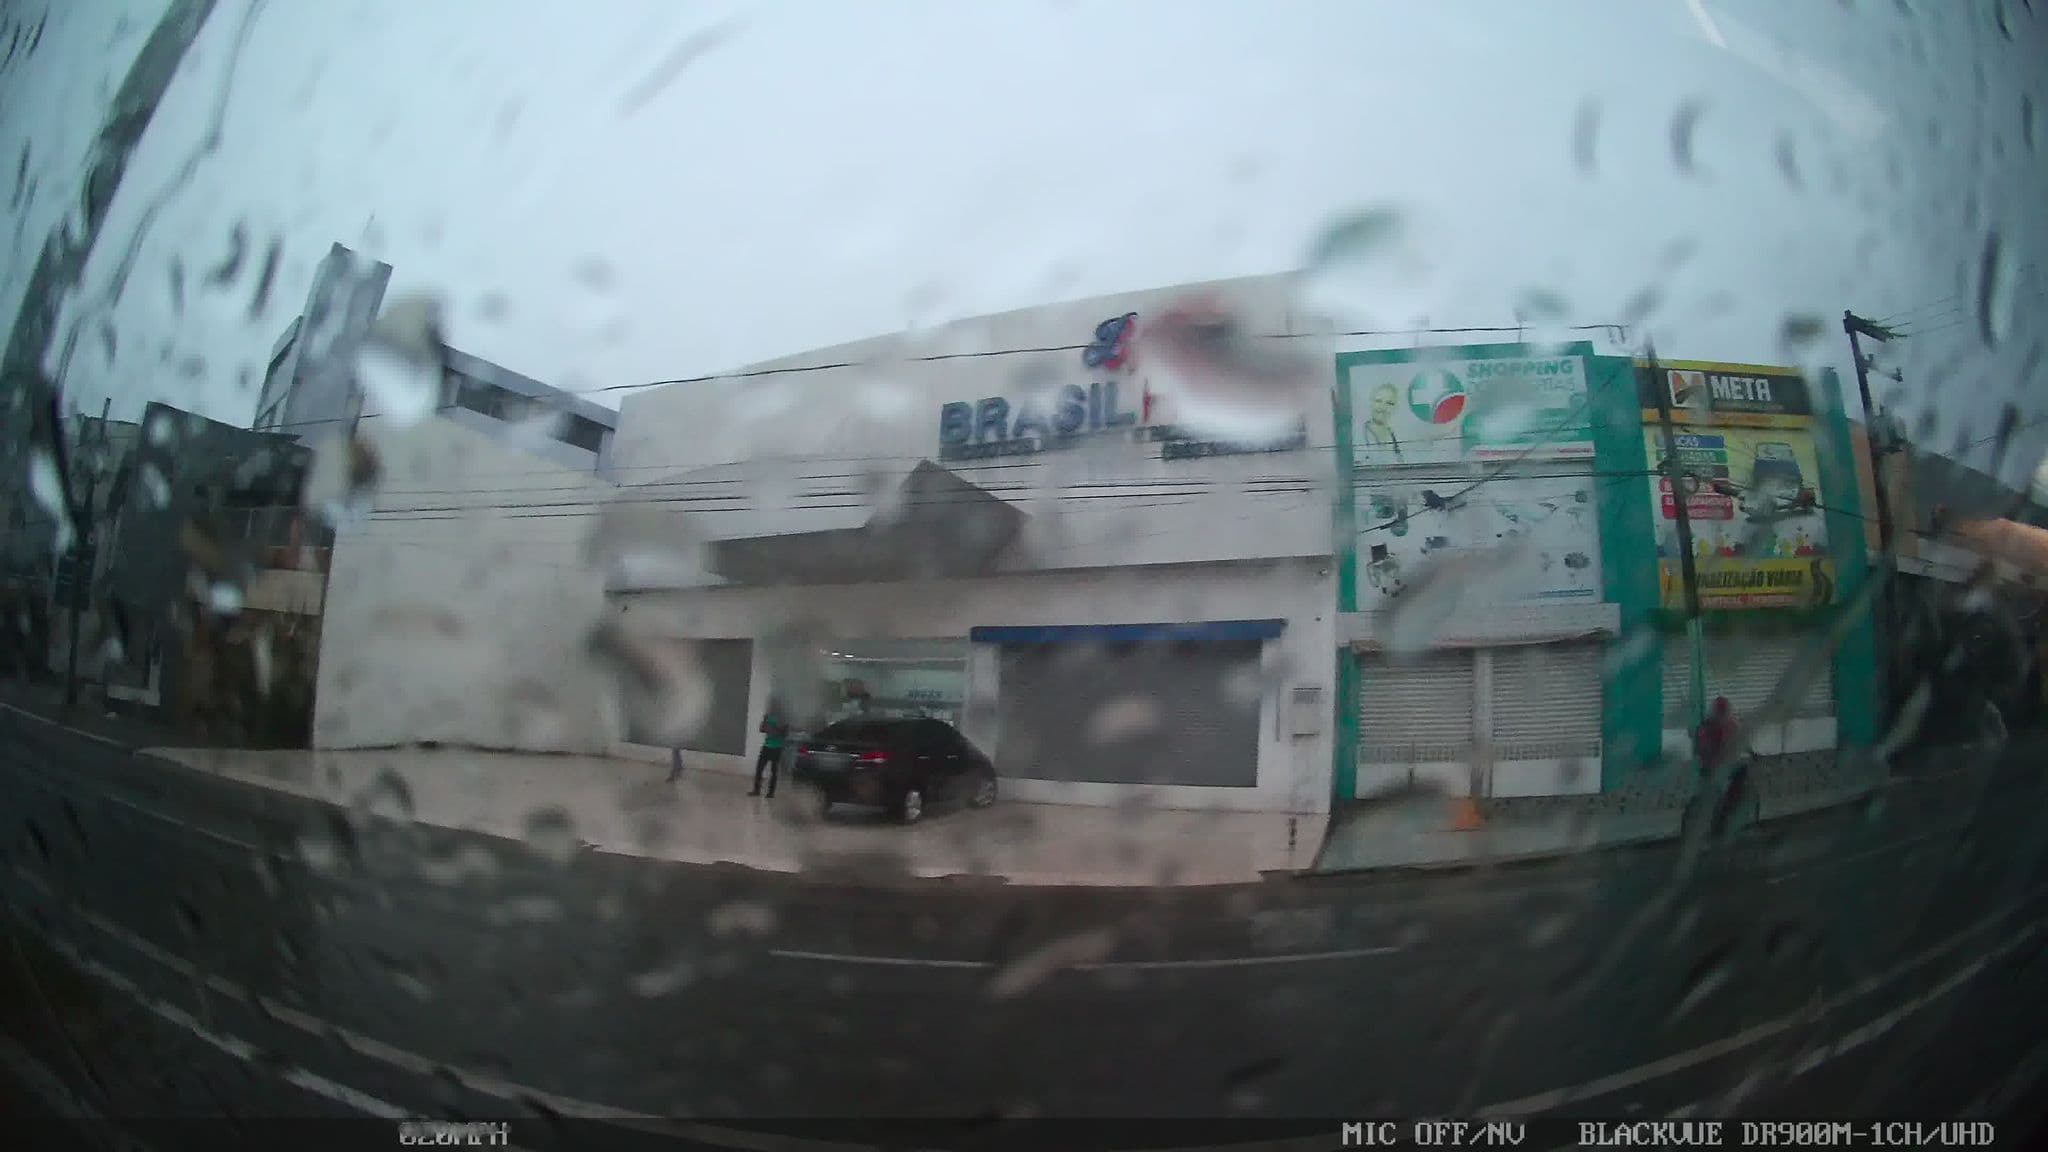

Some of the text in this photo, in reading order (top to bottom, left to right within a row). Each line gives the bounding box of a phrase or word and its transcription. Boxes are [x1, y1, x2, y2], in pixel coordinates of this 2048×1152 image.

[1466, 359, 1574, 378] SHOPPING
[1710, 375, 1772, 401] META
[940, 381, 1135, 445] BRASIL
